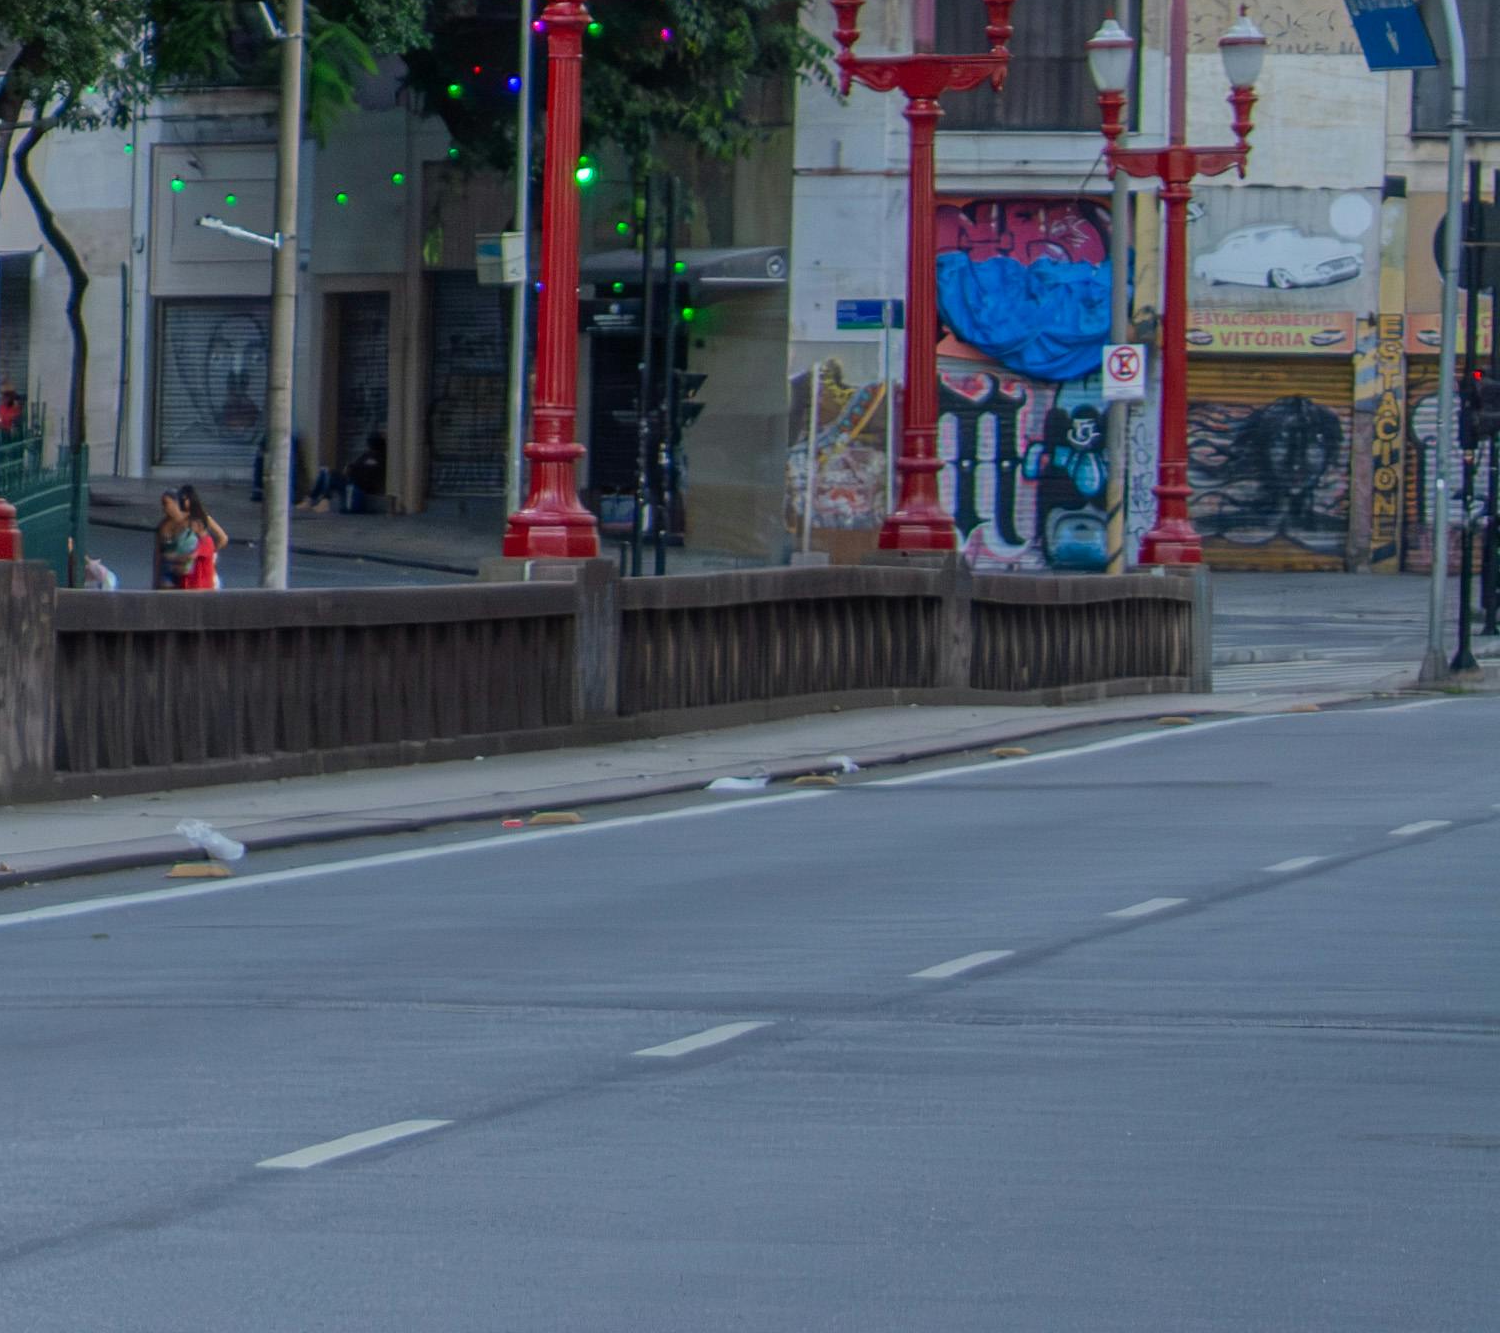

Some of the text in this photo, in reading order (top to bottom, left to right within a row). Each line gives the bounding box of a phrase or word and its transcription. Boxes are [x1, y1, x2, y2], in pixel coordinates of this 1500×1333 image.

[1193, 312, 1334, 326] ESTACIONAMENTO
[1219, 327, 1305, 346] VITÓRIA
[1372, 314, 1404, 542] ESTACIONE
